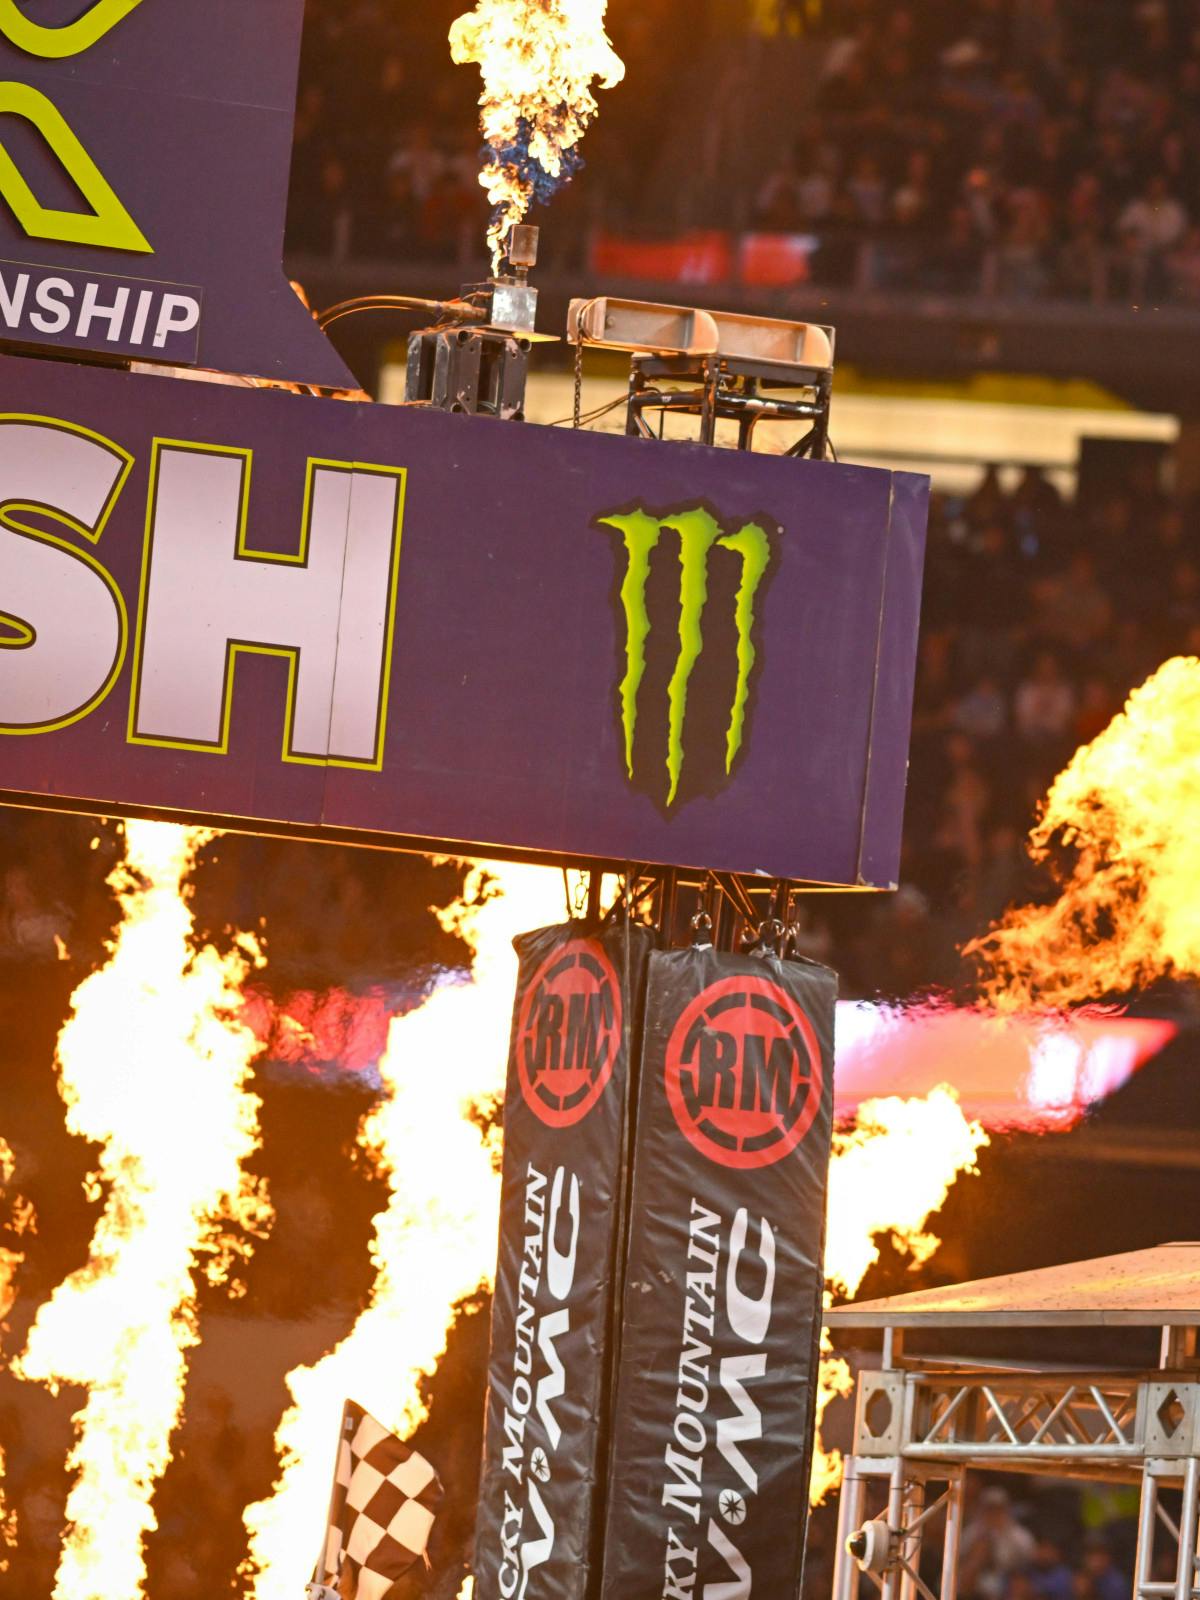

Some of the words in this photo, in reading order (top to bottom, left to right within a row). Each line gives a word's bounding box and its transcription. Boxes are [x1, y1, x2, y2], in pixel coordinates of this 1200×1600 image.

[533, 991, 607, 1071] RM
[696, 1026, 801, 1113] RM
[502, 1162, 547, 1485] MOUNTAIN
[661, 1198, 722, 1524] MOUNTAIN
